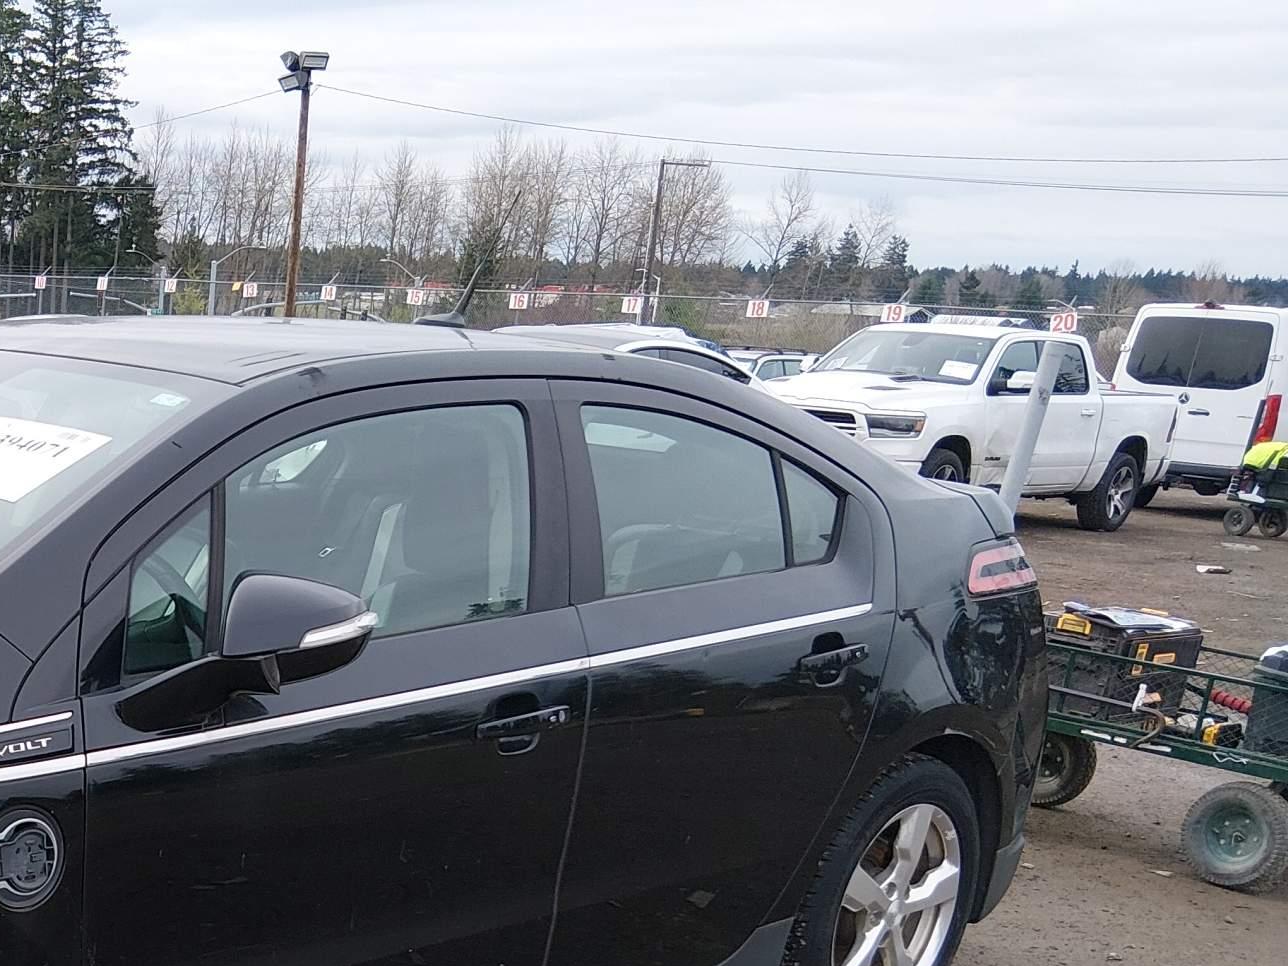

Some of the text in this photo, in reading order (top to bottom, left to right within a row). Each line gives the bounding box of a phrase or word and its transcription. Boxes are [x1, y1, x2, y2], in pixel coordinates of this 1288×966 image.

[246, 284, 253, 296] 13
[325, 287, 333, 299] 14
[410, 291, 420, 303] 15
[513, 295, 524, 307] 16
[627, 299, 637, 312] 17
[751, 302, 764, 315] 18
[886, 306, 901, 321] 19
[1053, 314, 1074, 331] 20
